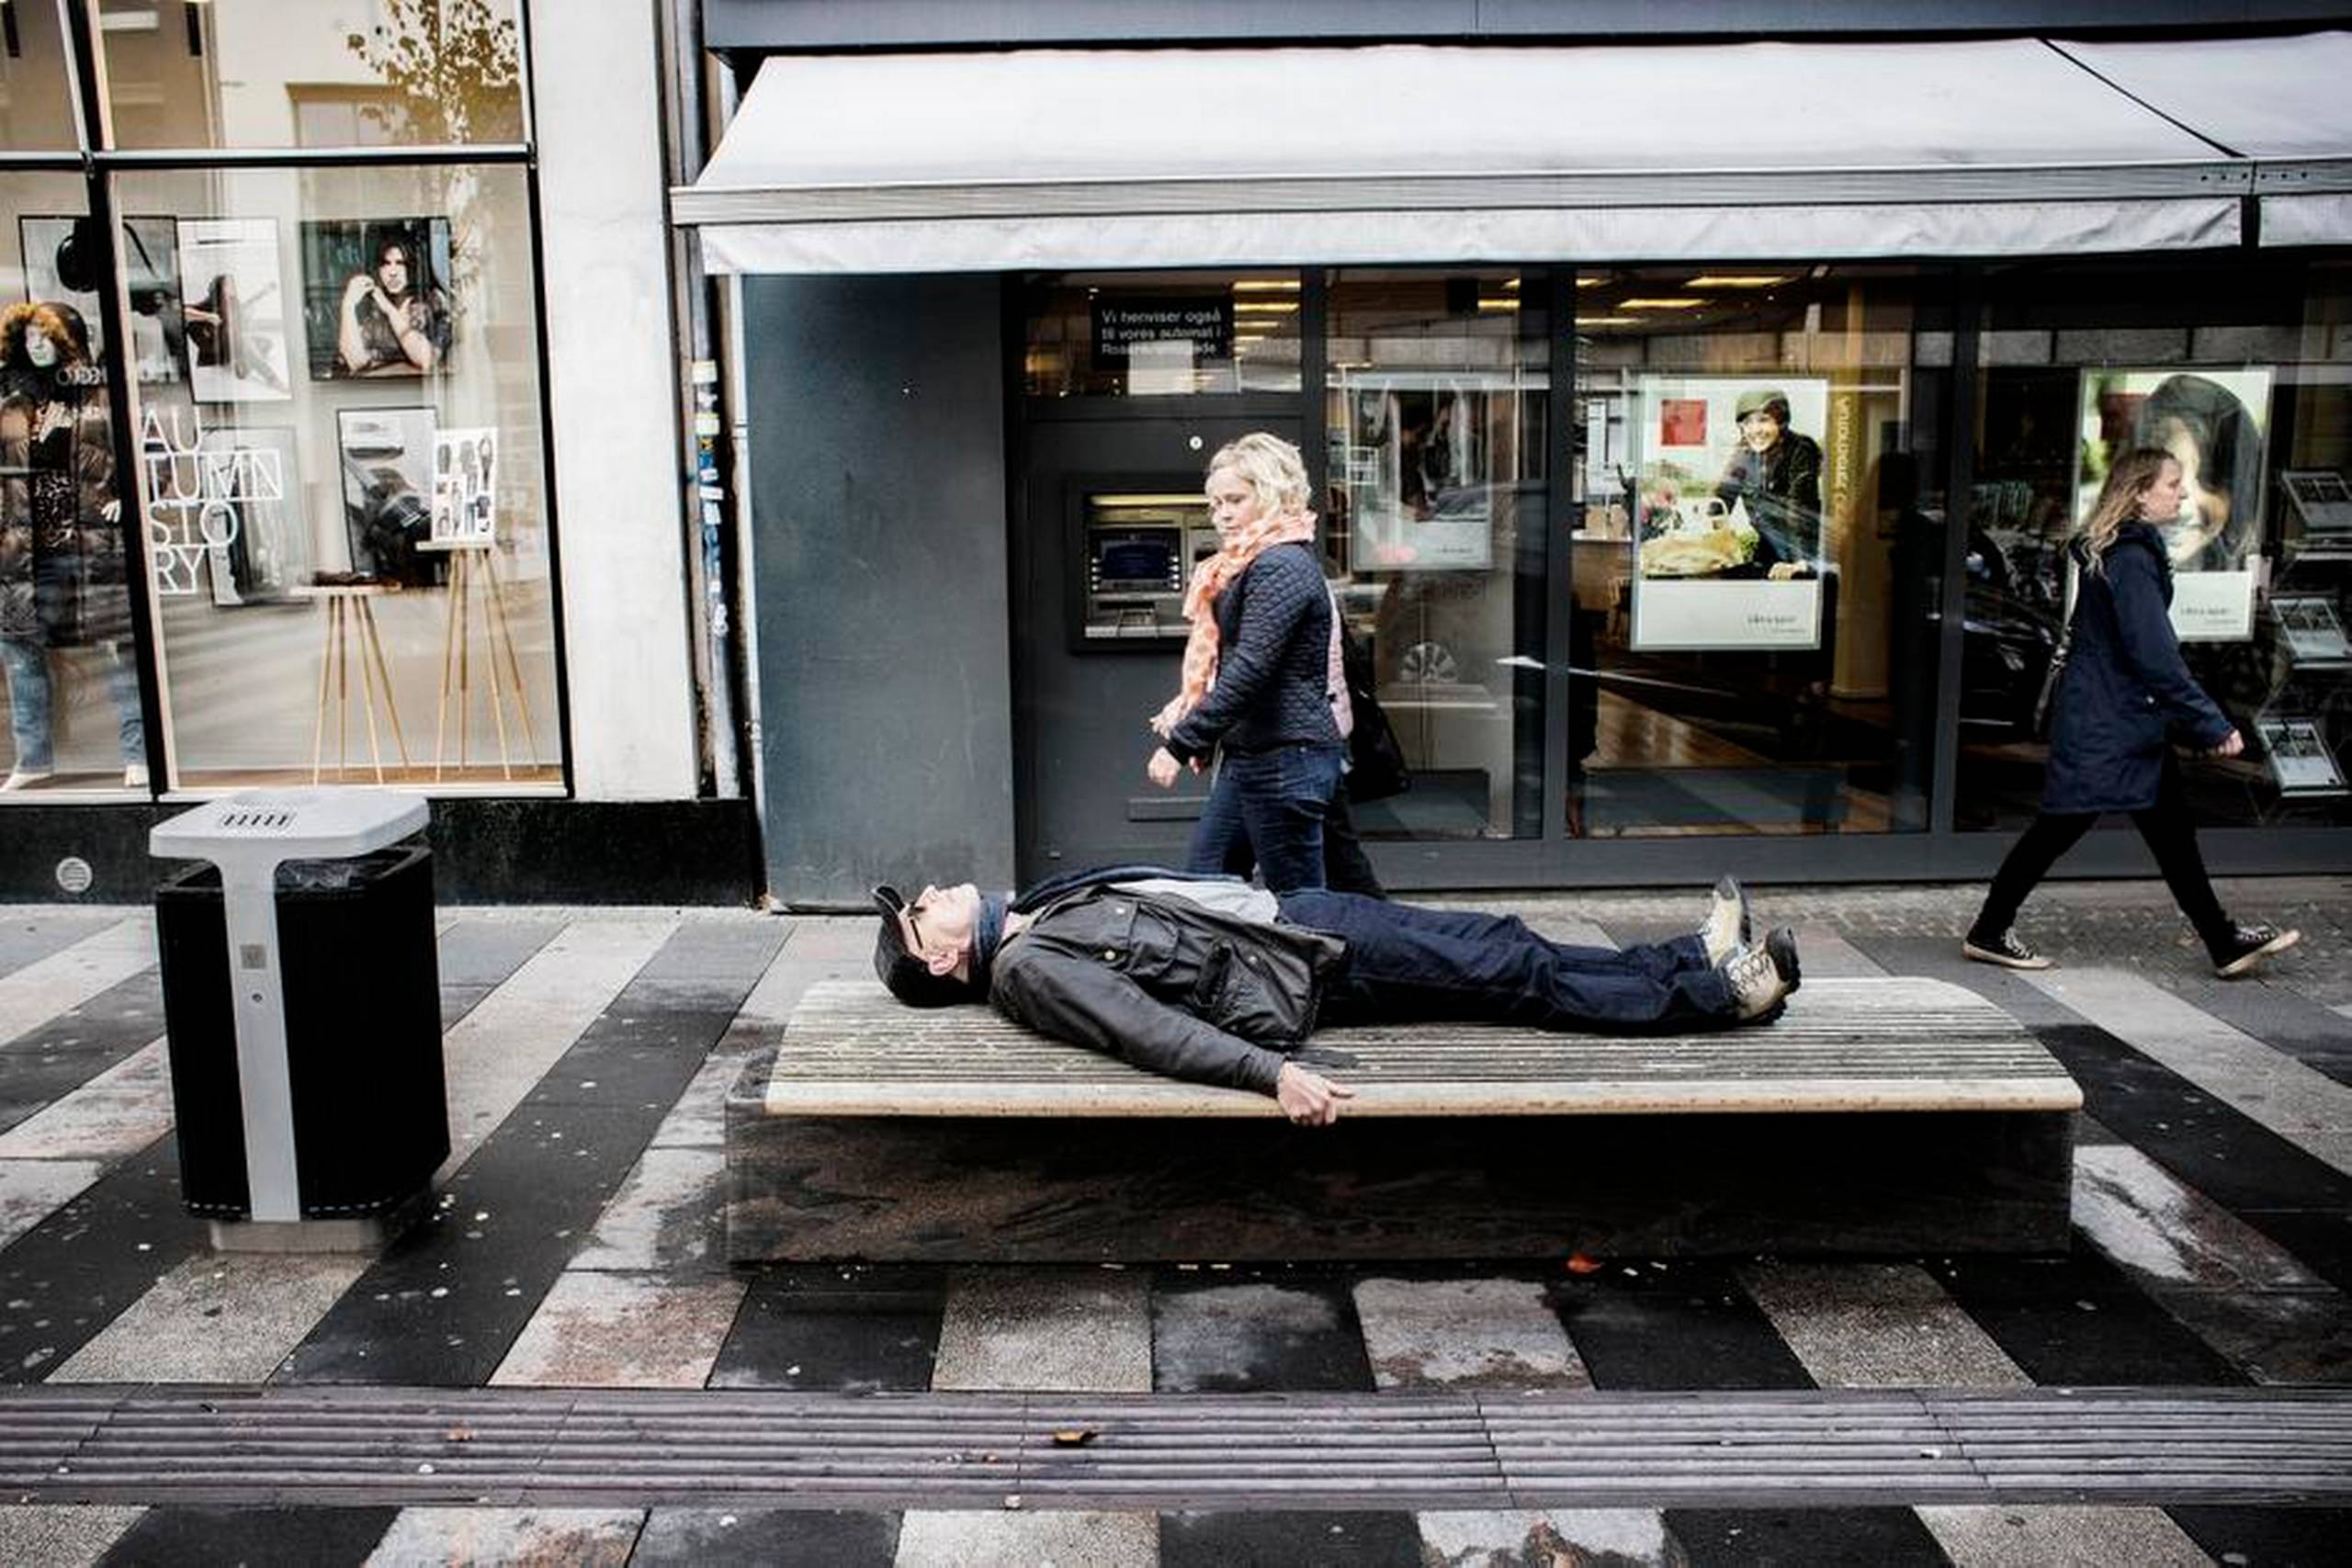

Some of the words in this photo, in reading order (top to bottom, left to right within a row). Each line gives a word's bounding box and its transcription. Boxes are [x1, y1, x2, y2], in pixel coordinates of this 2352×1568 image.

[1102, 310, 1117, 323] Vi
[1121, 310, 1182, 322] henviser
[1184, 306, 1222, 326] også
[1102, 327, 1114, 340] til
[1119, 328, 1155, 340] vores
[1159, 326, 1213, 339] automat
[141, 405, 202, 455] AU
[144, 449, 284, 501] TUMN
[147, 500, 239, 548] STO
[153, 544, 208, 595] RY
